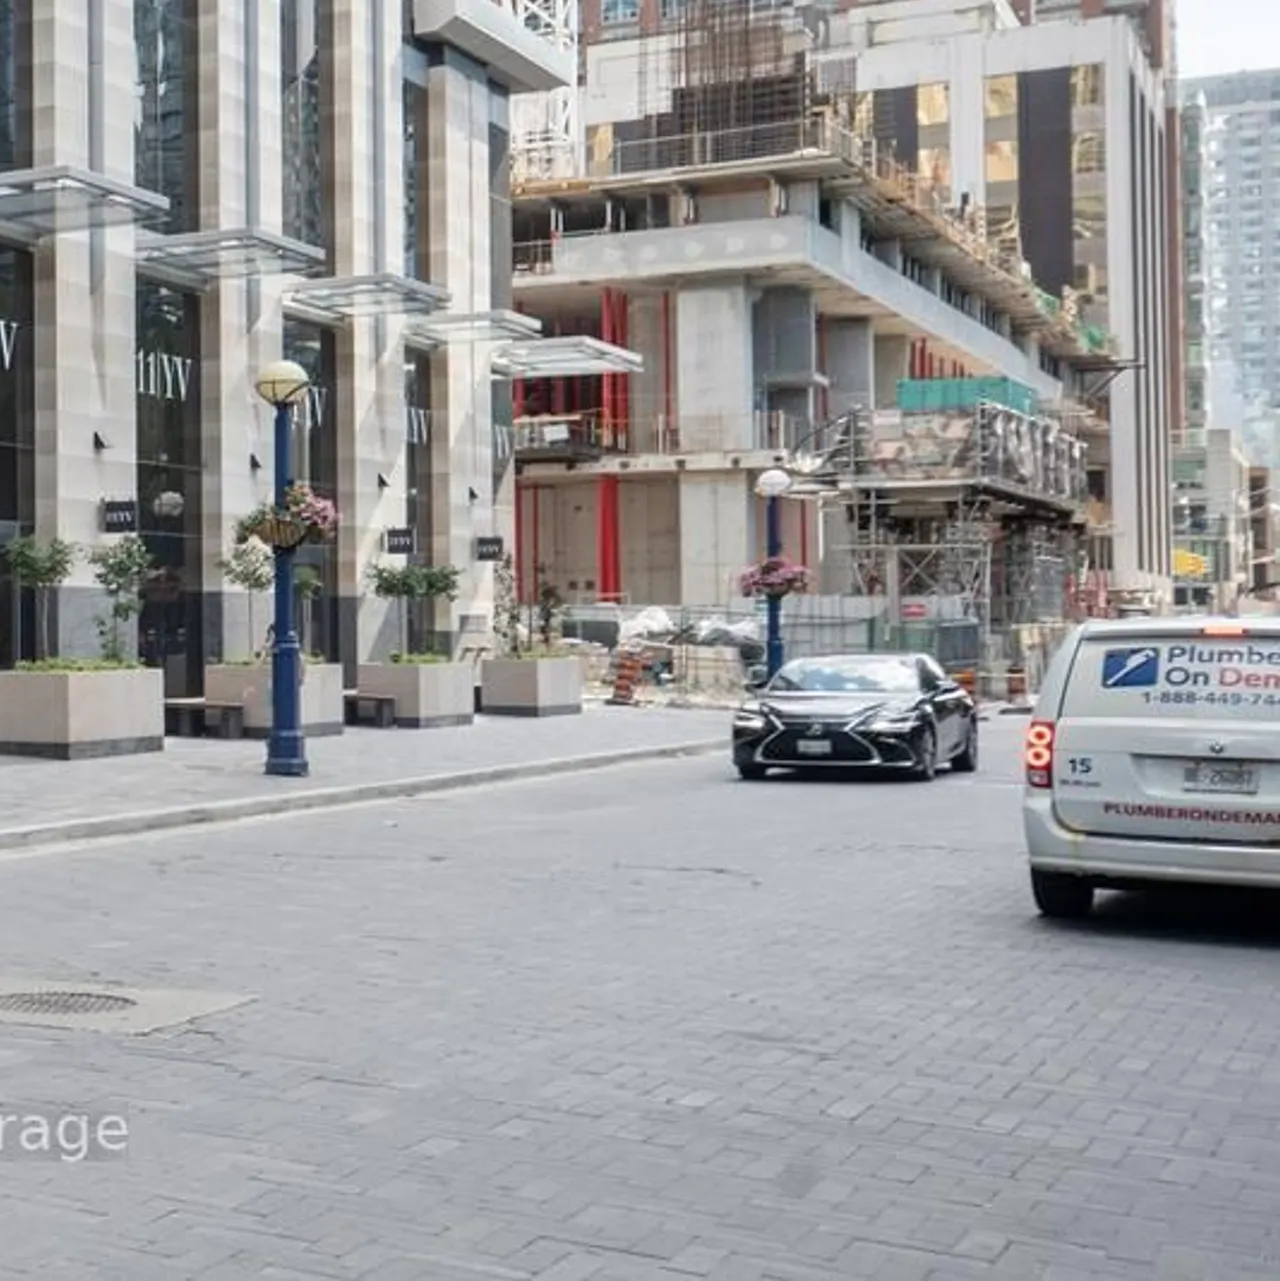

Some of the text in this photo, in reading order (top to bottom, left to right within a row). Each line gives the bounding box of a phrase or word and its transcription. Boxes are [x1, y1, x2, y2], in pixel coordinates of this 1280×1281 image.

[1165, 667, 1209, 687] On
[1069, 757, 1092, 774] 15
[1104, 802, 1280, 824] PLUMBERONDEMA
